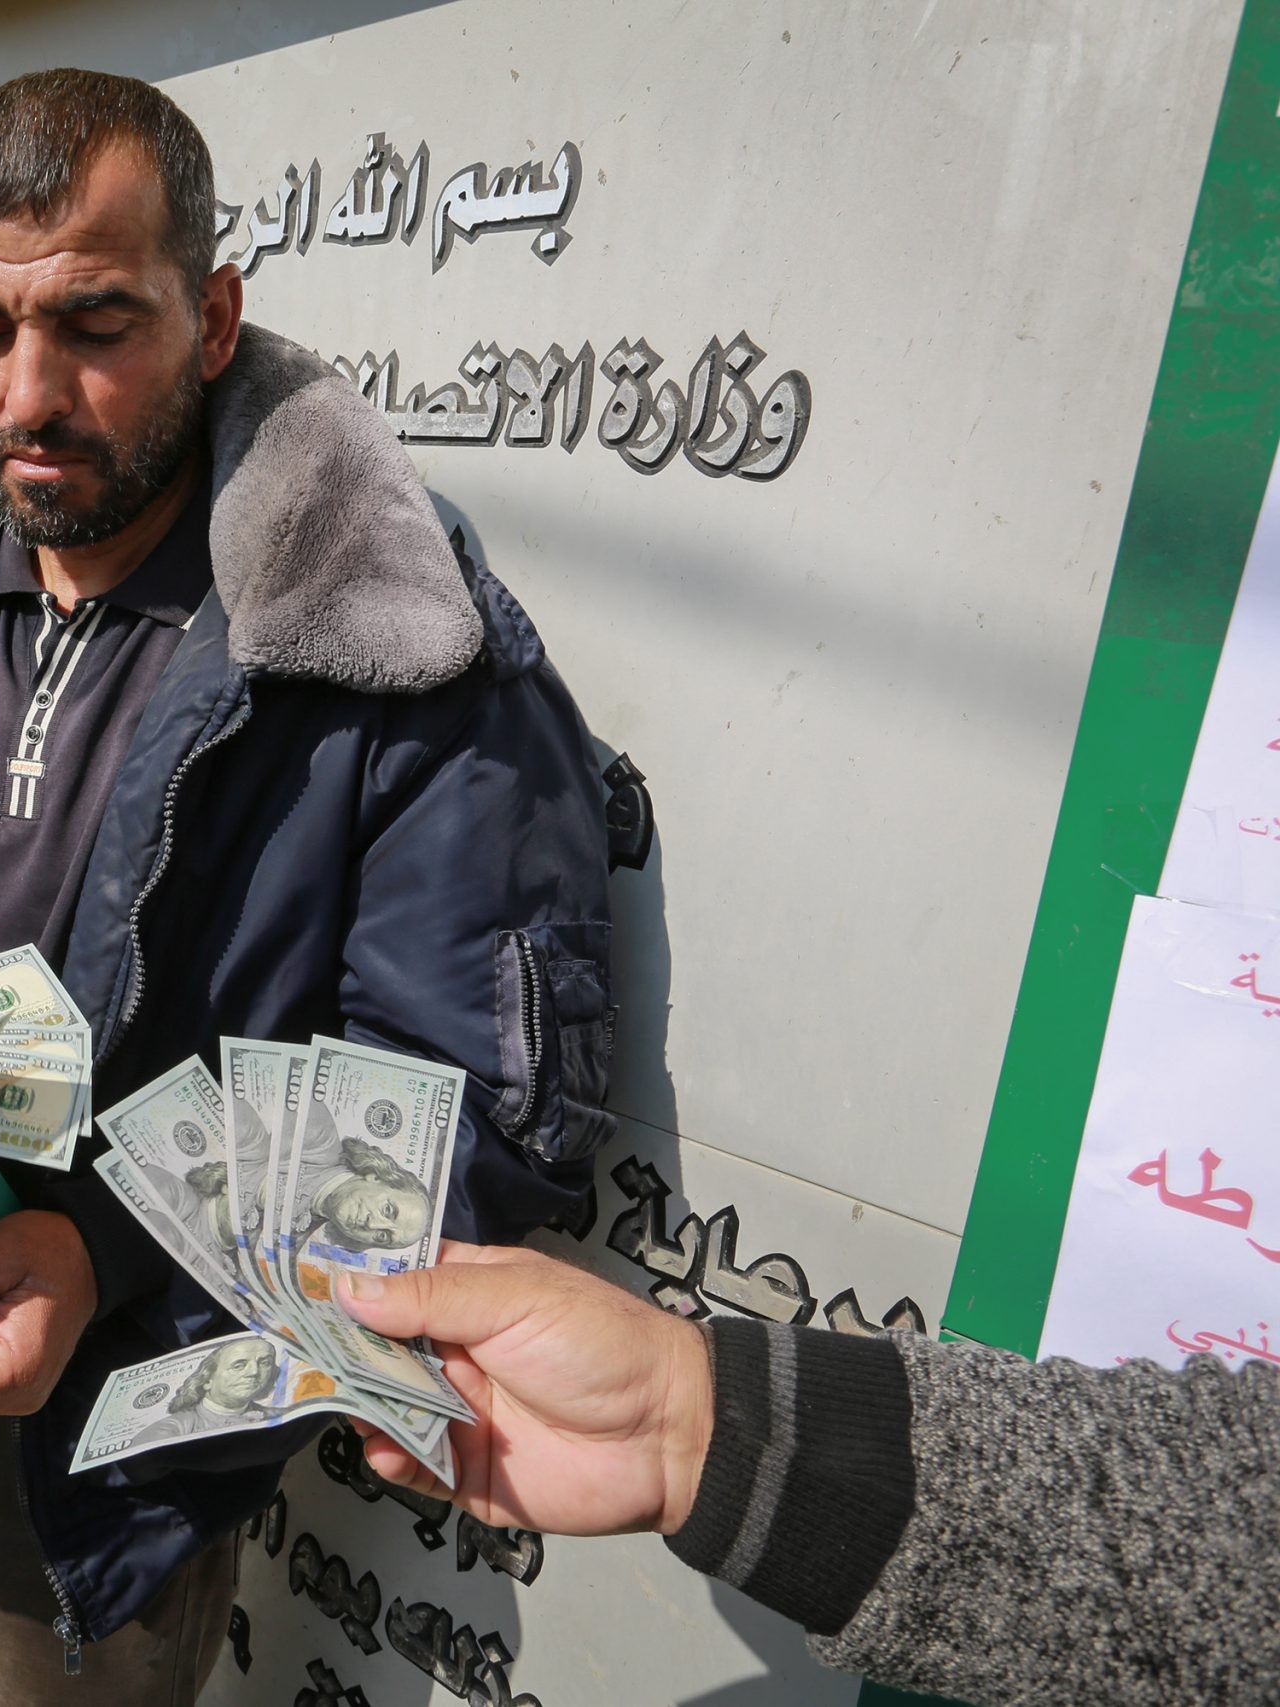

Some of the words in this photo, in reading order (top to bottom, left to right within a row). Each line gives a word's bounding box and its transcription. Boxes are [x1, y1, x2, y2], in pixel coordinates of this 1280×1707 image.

[323, 132, 430, 246] الله
[433, 140, 582, 275] بسم
[598, 330, 811, 482] وزارة
[192, 1070, 225, 1113] 100
[230, 1056, 246, 1100] 100
[285, 1064, 304, 1112] 100
[312, 1056, 332, 1103] 100
[433, 1081, 455, 1130] 100
[116, 1131, 149, 1168] 100
[115, 1176, 150, 1213] 100
[90, 1439, 133, 1458] 100
